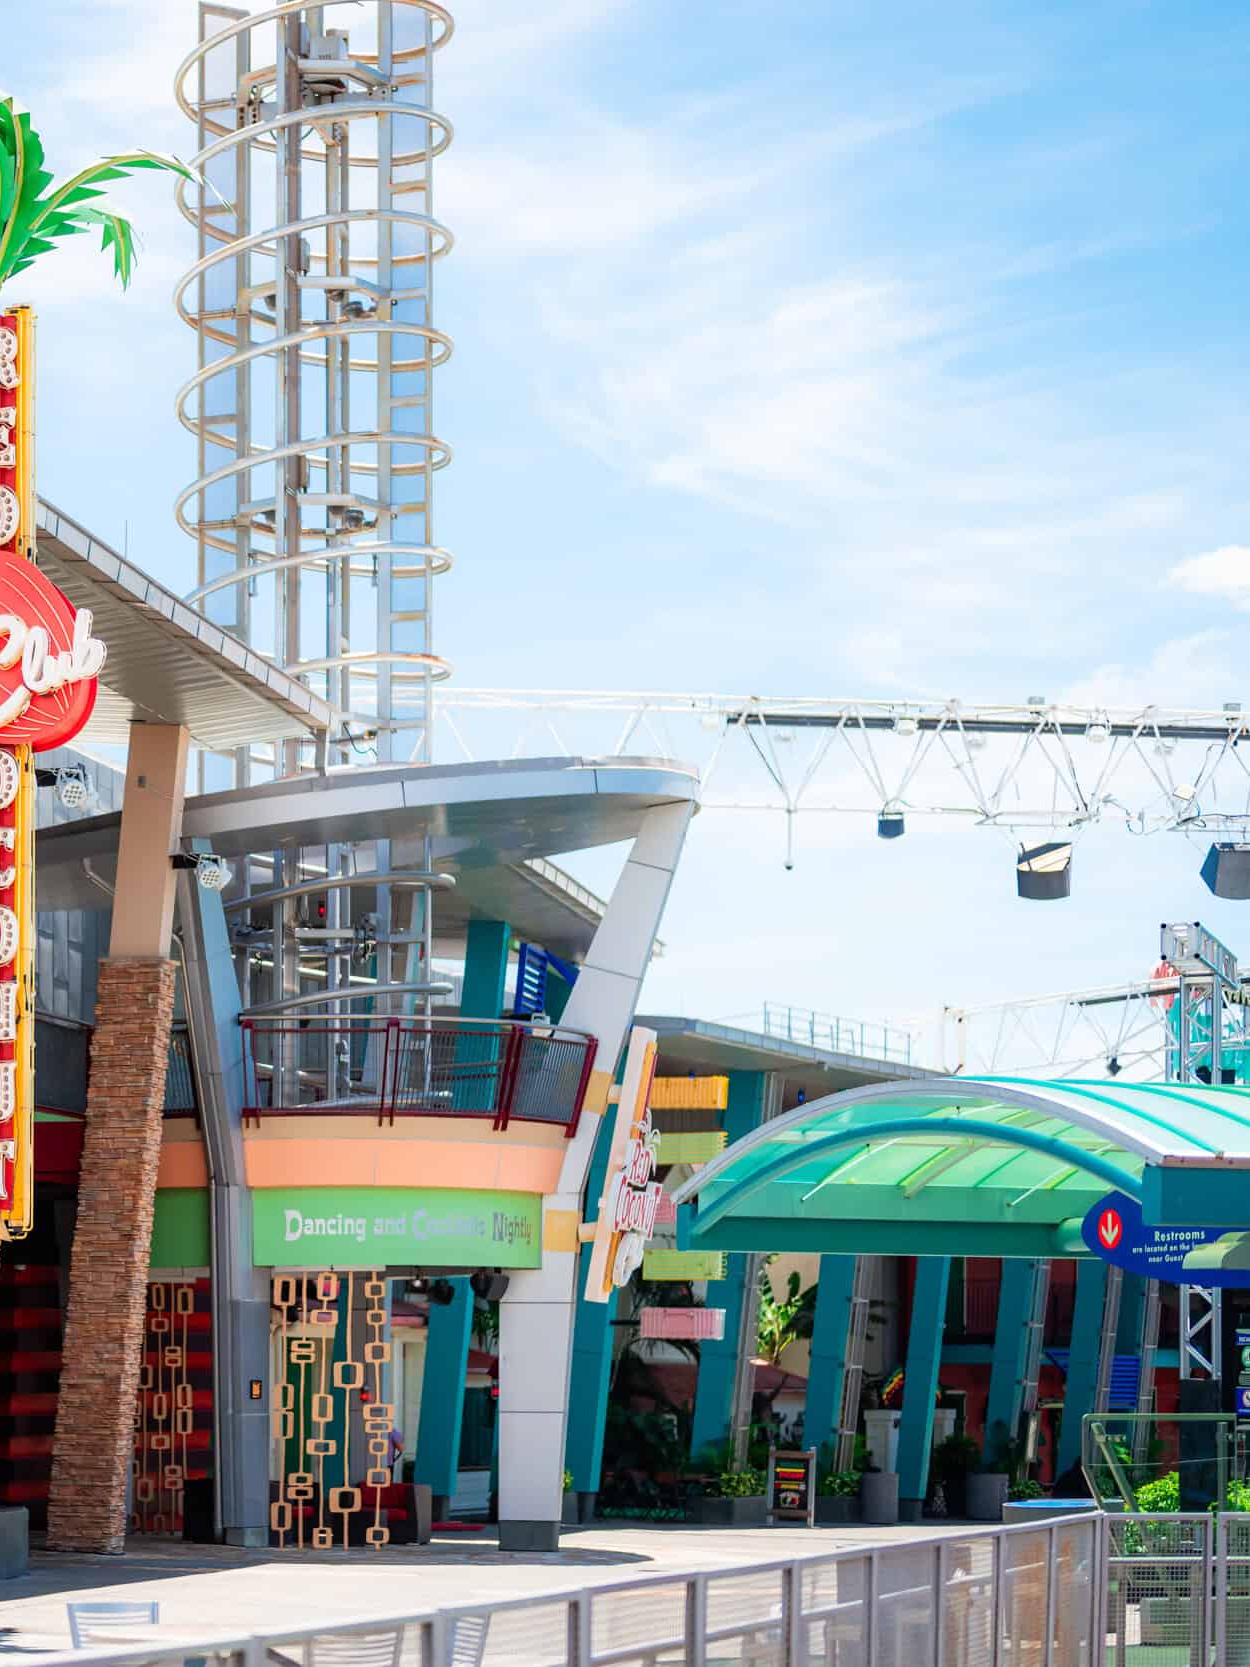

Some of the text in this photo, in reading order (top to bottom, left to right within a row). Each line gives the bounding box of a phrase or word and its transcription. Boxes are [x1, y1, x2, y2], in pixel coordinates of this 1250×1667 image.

[285, 1210, 367, 1243] Dancing
[372, 1213, 406, 1236] and
[492, 1211, 533, 1246] Nightly
[1154, 1231, 1205, 1242] Restrooms
[1145, 1244, 1168, 1253] located
